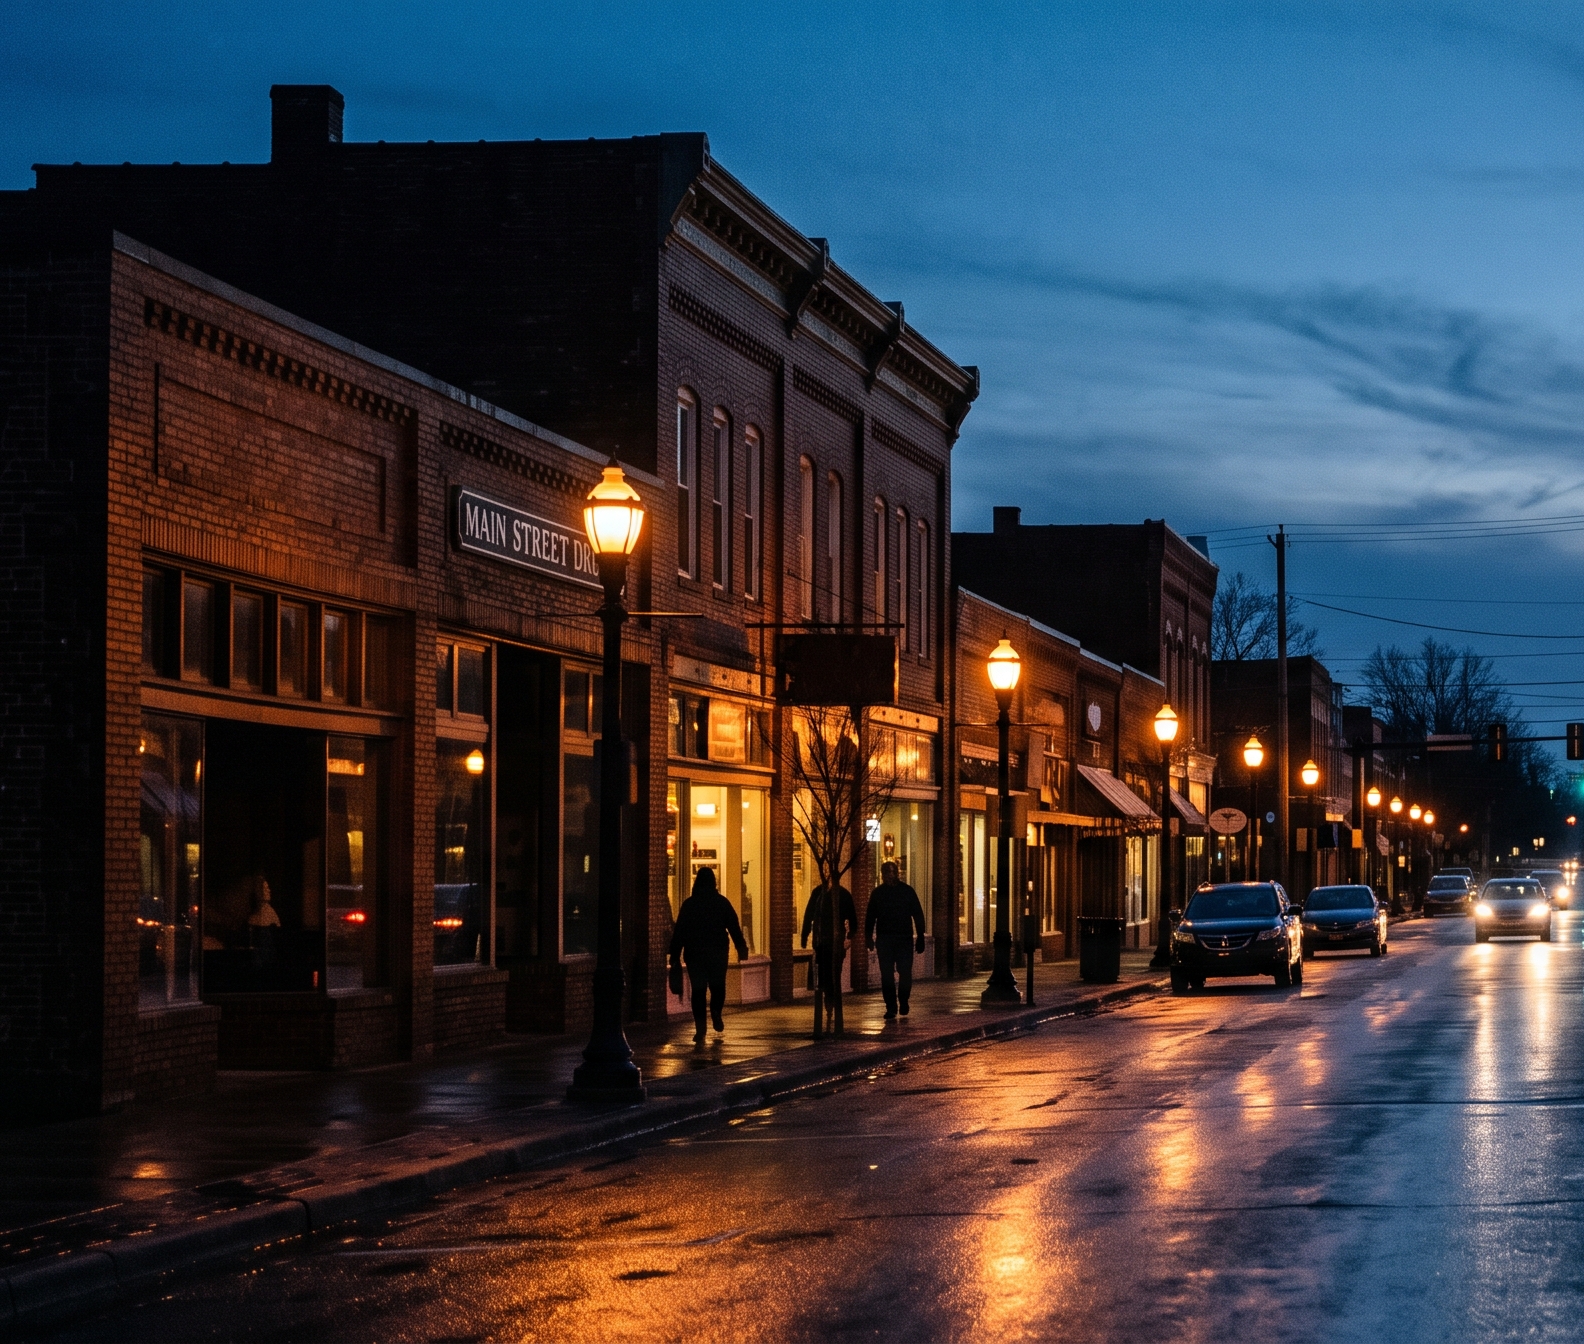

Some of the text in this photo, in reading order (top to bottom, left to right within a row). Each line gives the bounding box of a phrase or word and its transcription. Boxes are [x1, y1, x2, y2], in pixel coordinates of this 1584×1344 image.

[465, 502, 605, 577] MAIN STREET DRU
